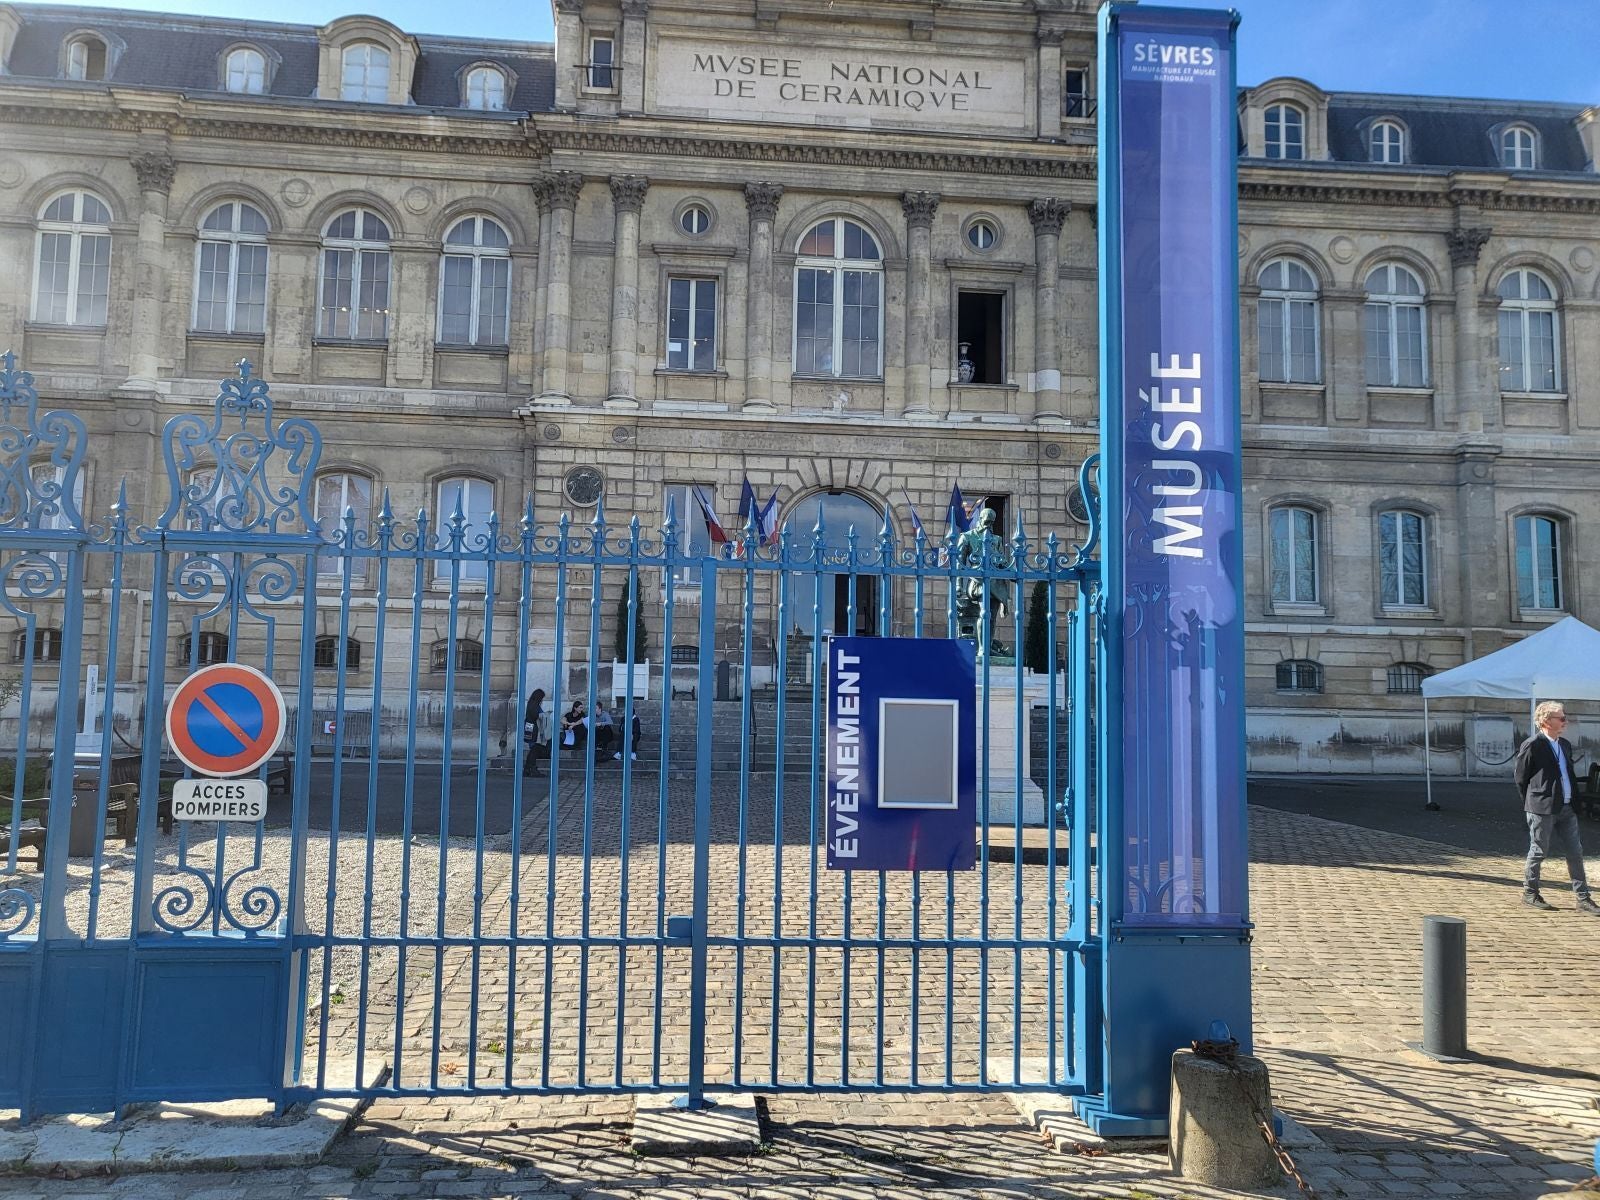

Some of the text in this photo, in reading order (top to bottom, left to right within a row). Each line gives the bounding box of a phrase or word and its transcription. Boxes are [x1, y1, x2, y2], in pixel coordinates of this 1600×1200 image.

[1134, 39, 1213, 65] SÈVRES
[693, 54, 993, 90] MVSEE NATIONAL
[1154, 74, 1194, 82] NATIONAUX
[1183, 67, 1191, 75] ET
[714, 78, 970, 112] DE CERAMIQVE
[1138, 352, 1204, 559] MUSÉE
[829, 649, 861, 858] ÉVÈNEMENT
[192, 785, 245, 799] ACCES
[175, 802, 259, 816] POMPIERS
